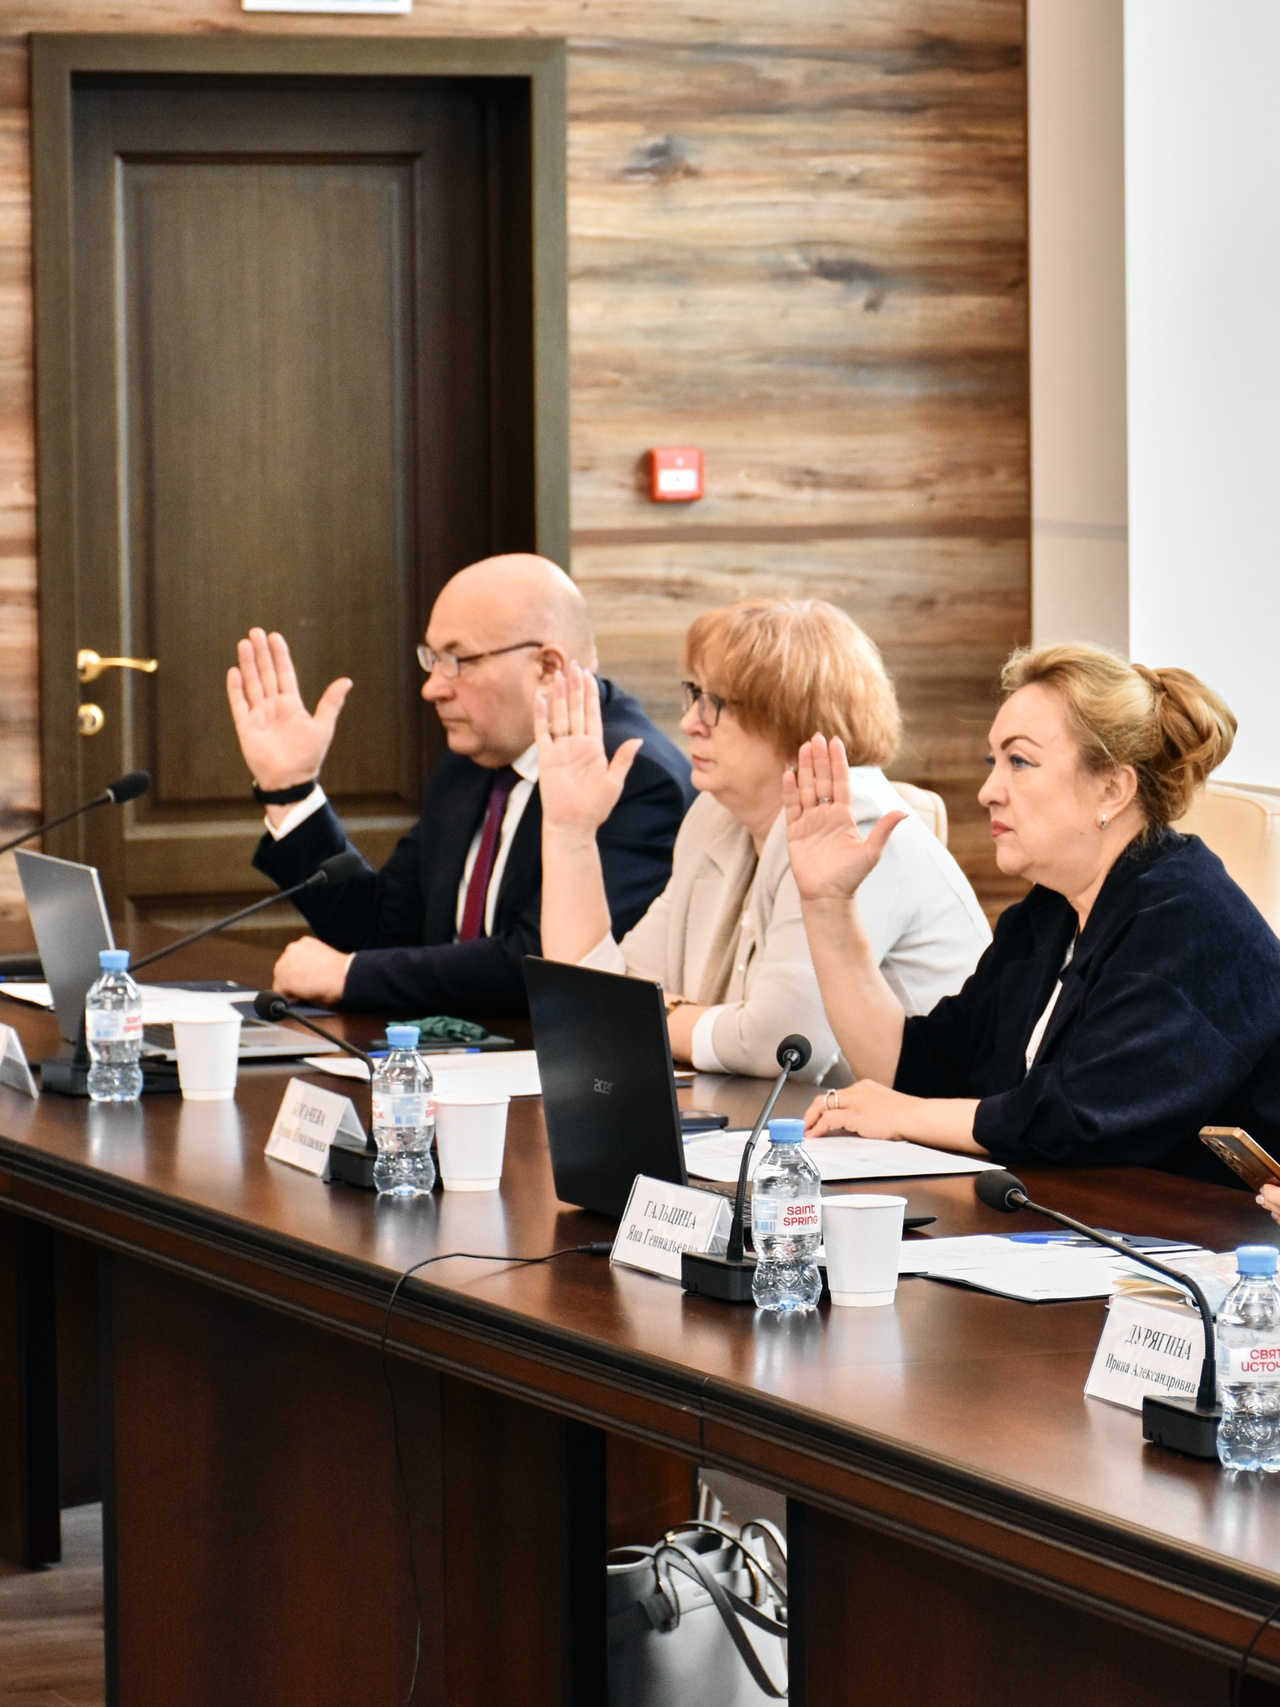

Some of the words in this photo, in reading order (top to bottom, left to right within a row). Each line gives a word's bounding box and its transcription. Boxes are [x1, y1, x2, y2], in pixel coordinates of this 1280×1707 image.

[643, 1200, 697, 1230] ГАЛЬЦИНА
[626, 1224, 643, 1243] Яна
[1125, 1324, 1193, 1361] ДУРЯГИНА
[1105, 1353, 1131, 1374] Ирина
[1130, 1362, 1197, 1395] Александровна
